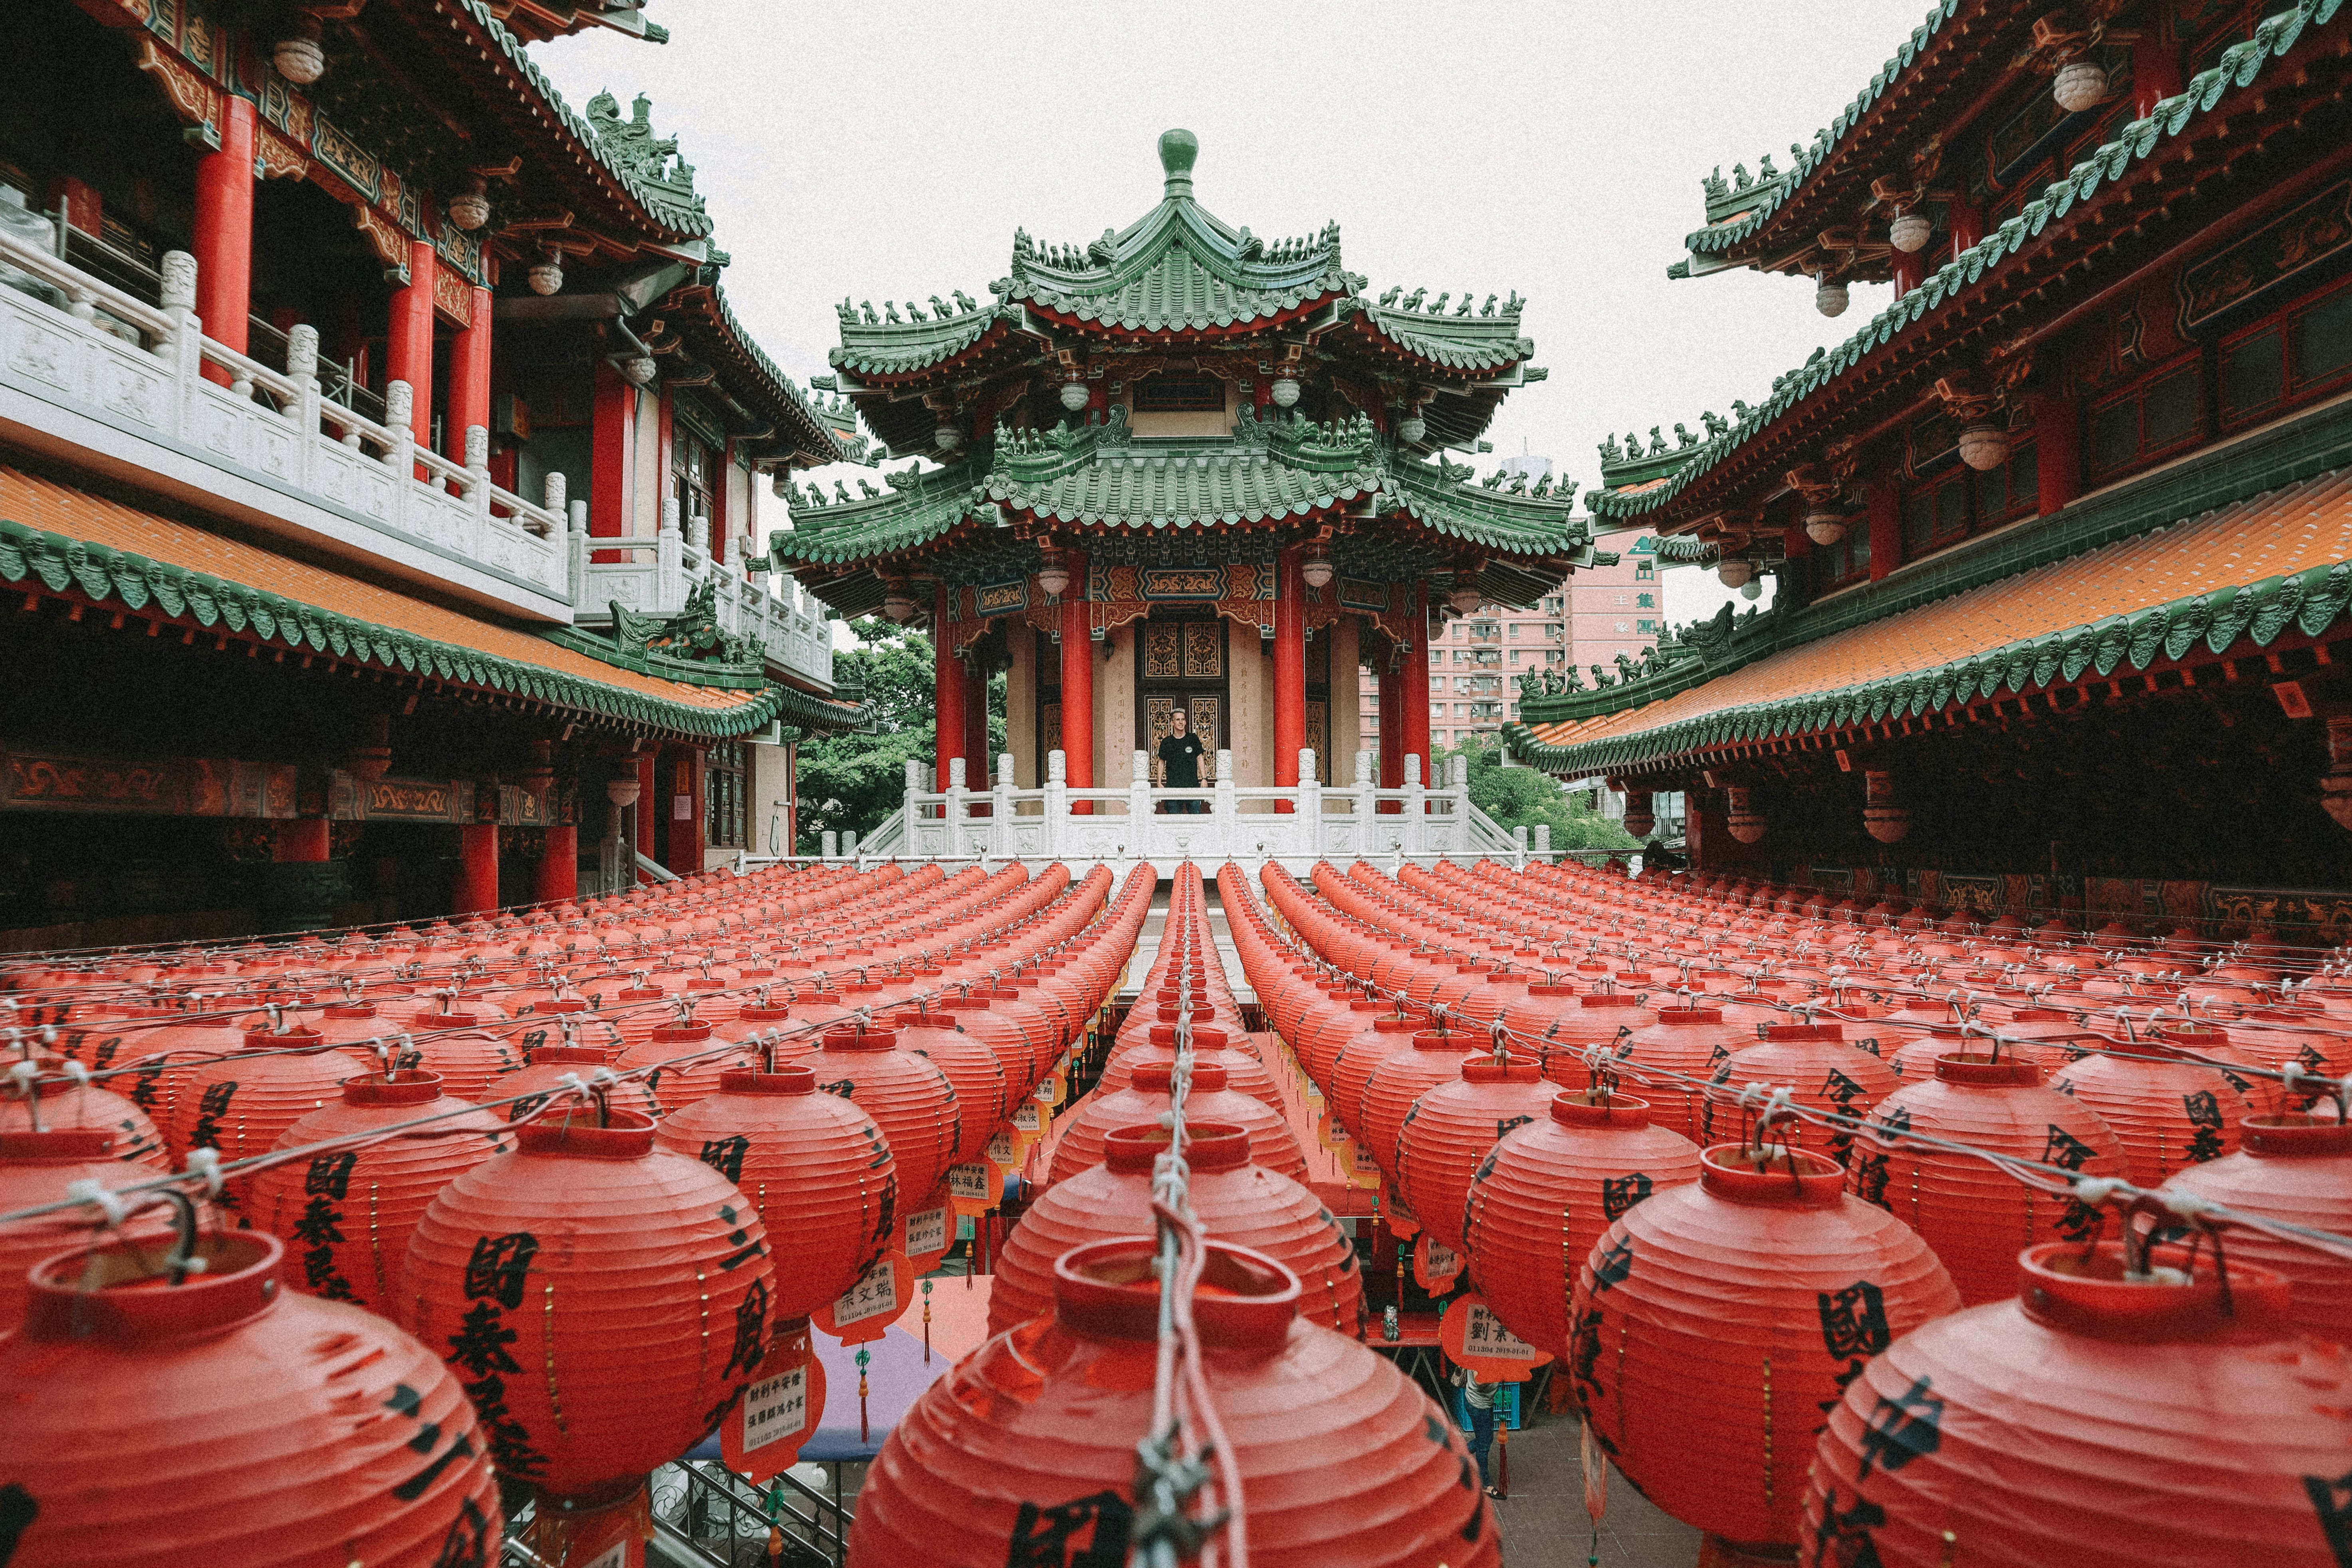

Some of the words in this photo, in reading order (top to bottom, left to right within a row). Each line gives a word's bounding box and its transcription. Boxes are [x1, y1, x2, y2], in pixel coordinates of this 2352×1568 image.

[950, 1174, 986, 1190] 林福鑫
[864, 1300, 892, 1314] 2019-01-01
[1495, 1347, 1529, 1356] 2019-01-01
[749, 1372, 801, 1405] 財利平安燈
